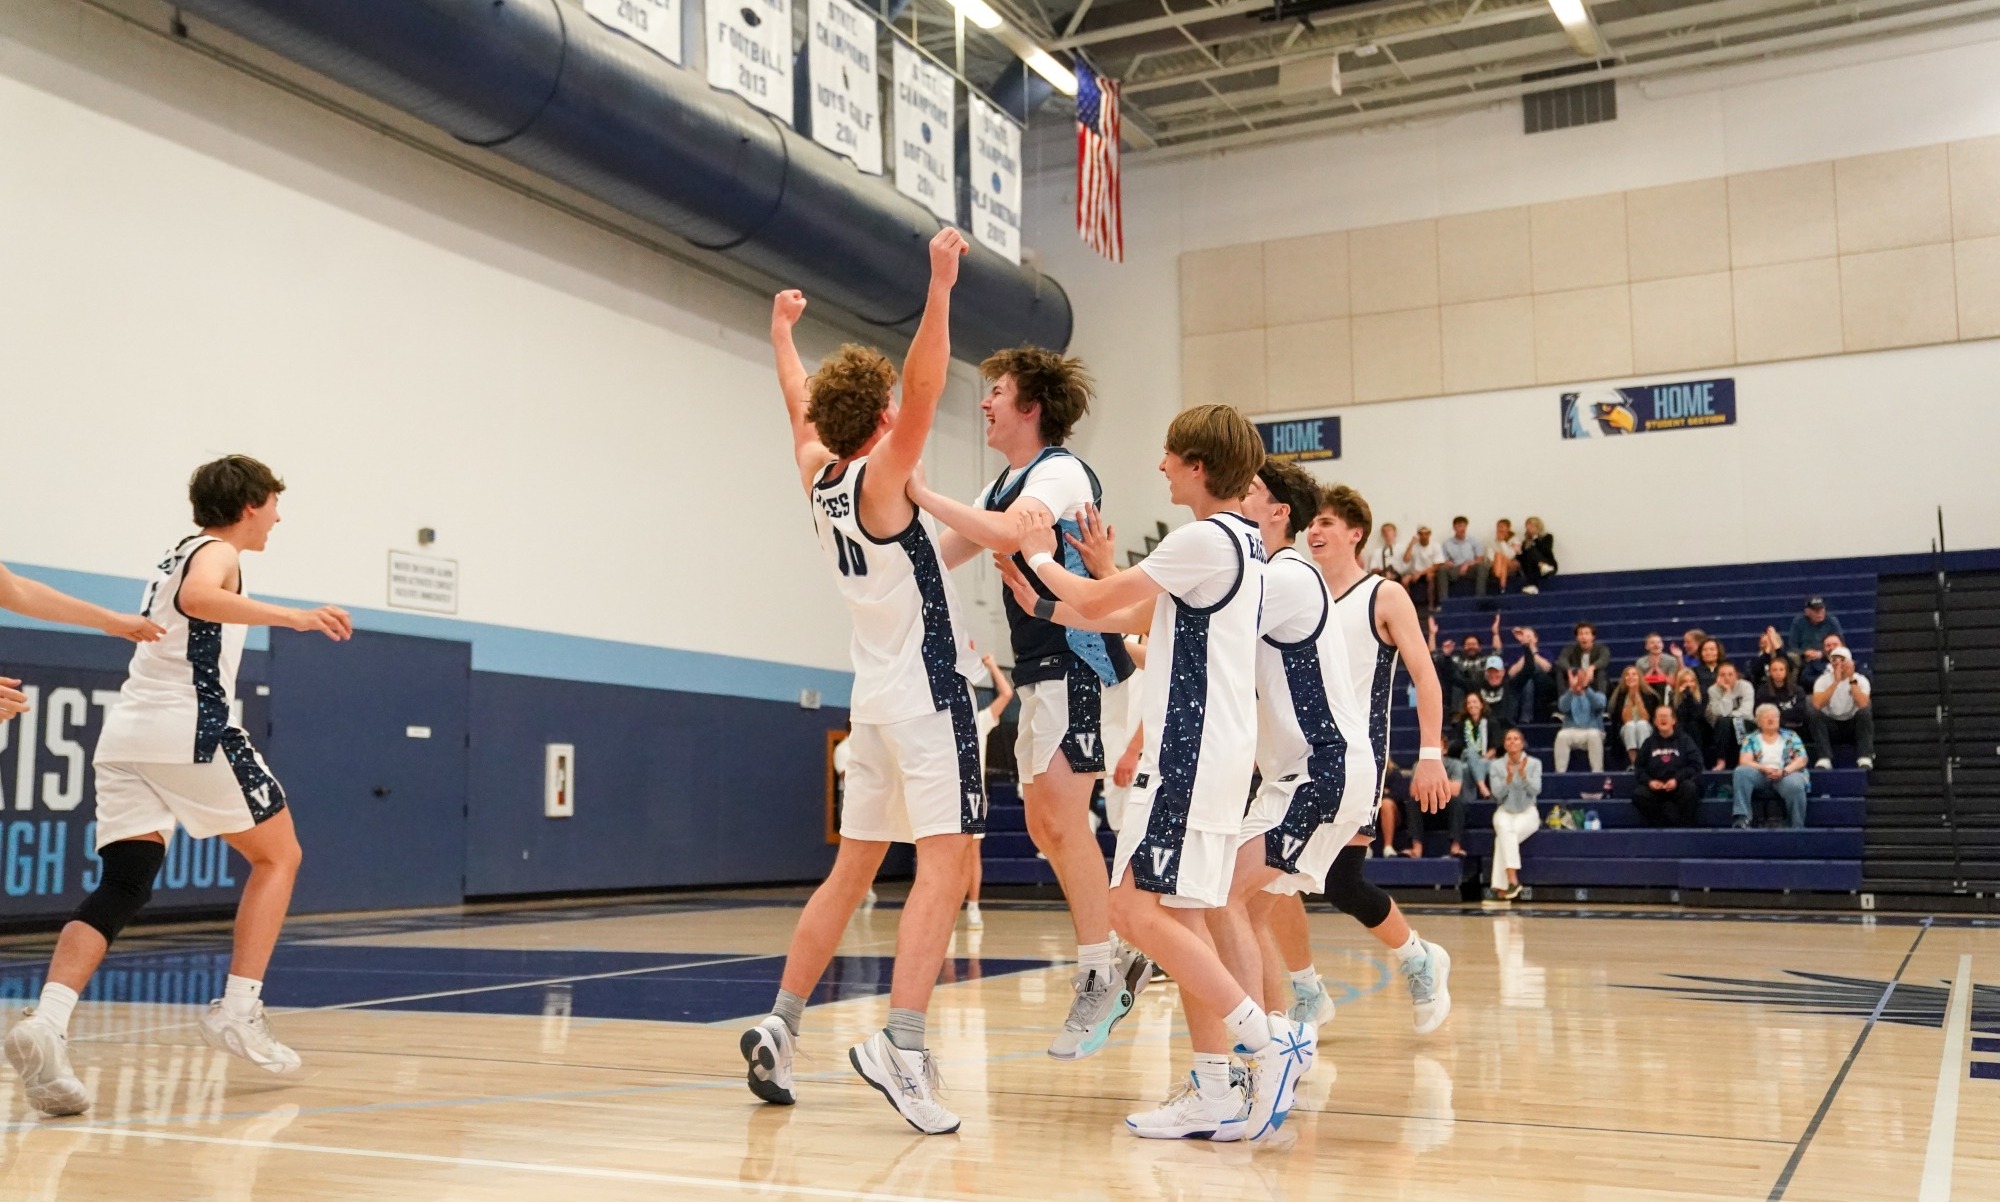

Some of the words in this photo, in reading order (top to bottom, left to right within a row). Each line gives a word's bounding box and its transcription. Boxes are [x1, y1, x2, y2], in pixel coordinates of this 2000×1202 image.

[617, 0, 648, 32] 2013
[719, 21, 785, 76] FOOTBALL
[739, 63, 767, 97] 2013
[1654, 383, 1714, 418] HOME
[1272, 420, 1325, 454] HOME
[1646, 419, 1686, 429] STUDENT
[1688, 415, 1725, 426] SECTION
[1075, 733, 1096, 759] V
[250, 781, 272, 809] V
[966, 792, 981, 820] V
[81, 820, 235, 892] SOOL
[1150, 846, 1175, 878] V
[1280, 833, 1305, 861] V
